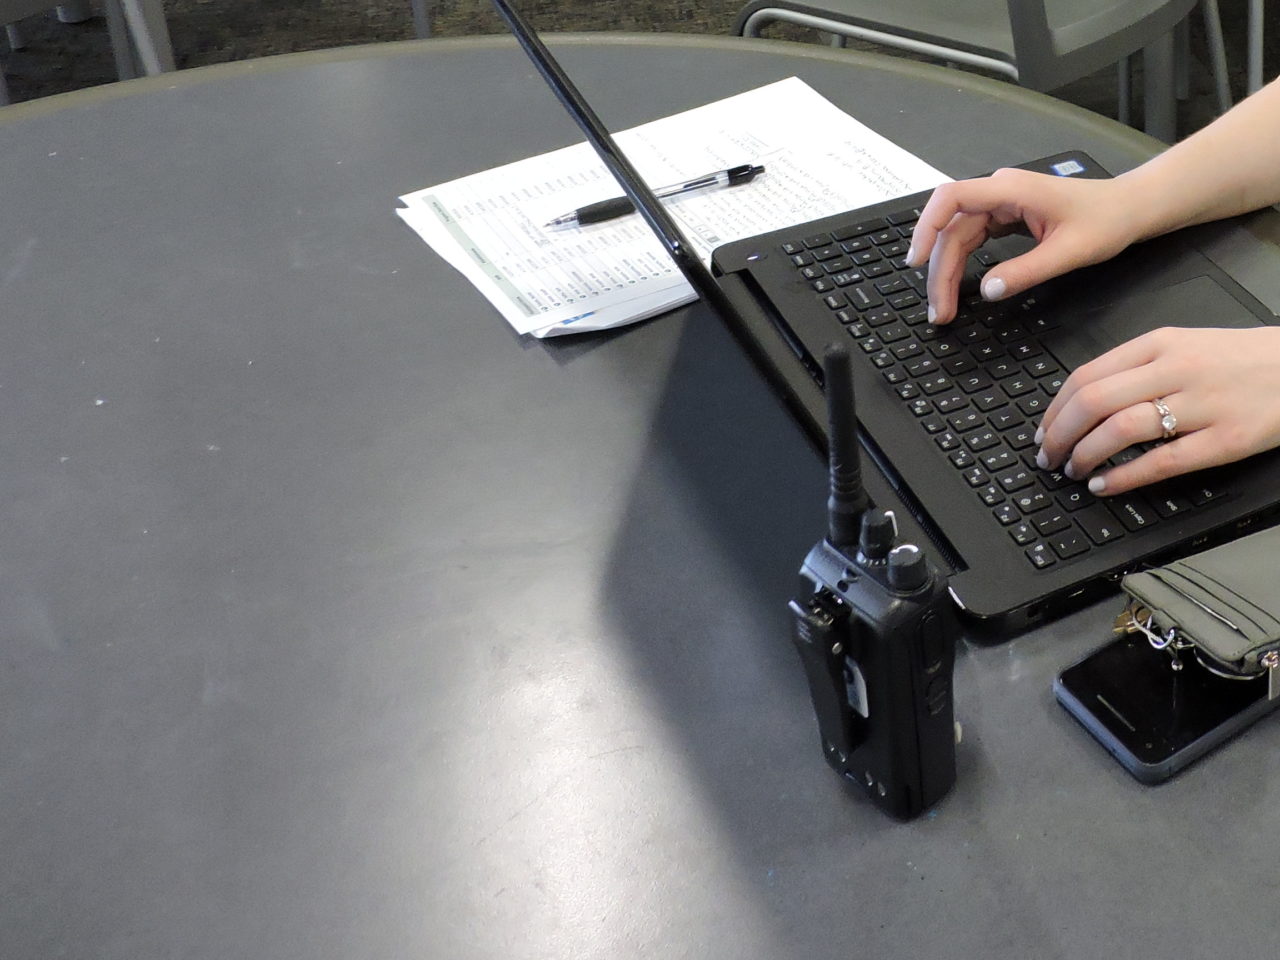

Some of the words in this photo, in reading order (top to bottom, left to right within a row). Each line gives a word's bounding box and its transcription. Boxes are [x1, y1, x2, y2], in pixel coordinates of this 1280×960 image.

[1019, 345, 1030, 353] M
[1035, 362, 1046, 370] N
[969, 377, 979, 385] U
[1012, 381, 1023, 389] H
[1051, 472, 1063, 482] W
[1070, 493, 1080, 501] Q
[1101, 527, 1111, 538] Tab
[1034, 555, 1045, 565] Esc
